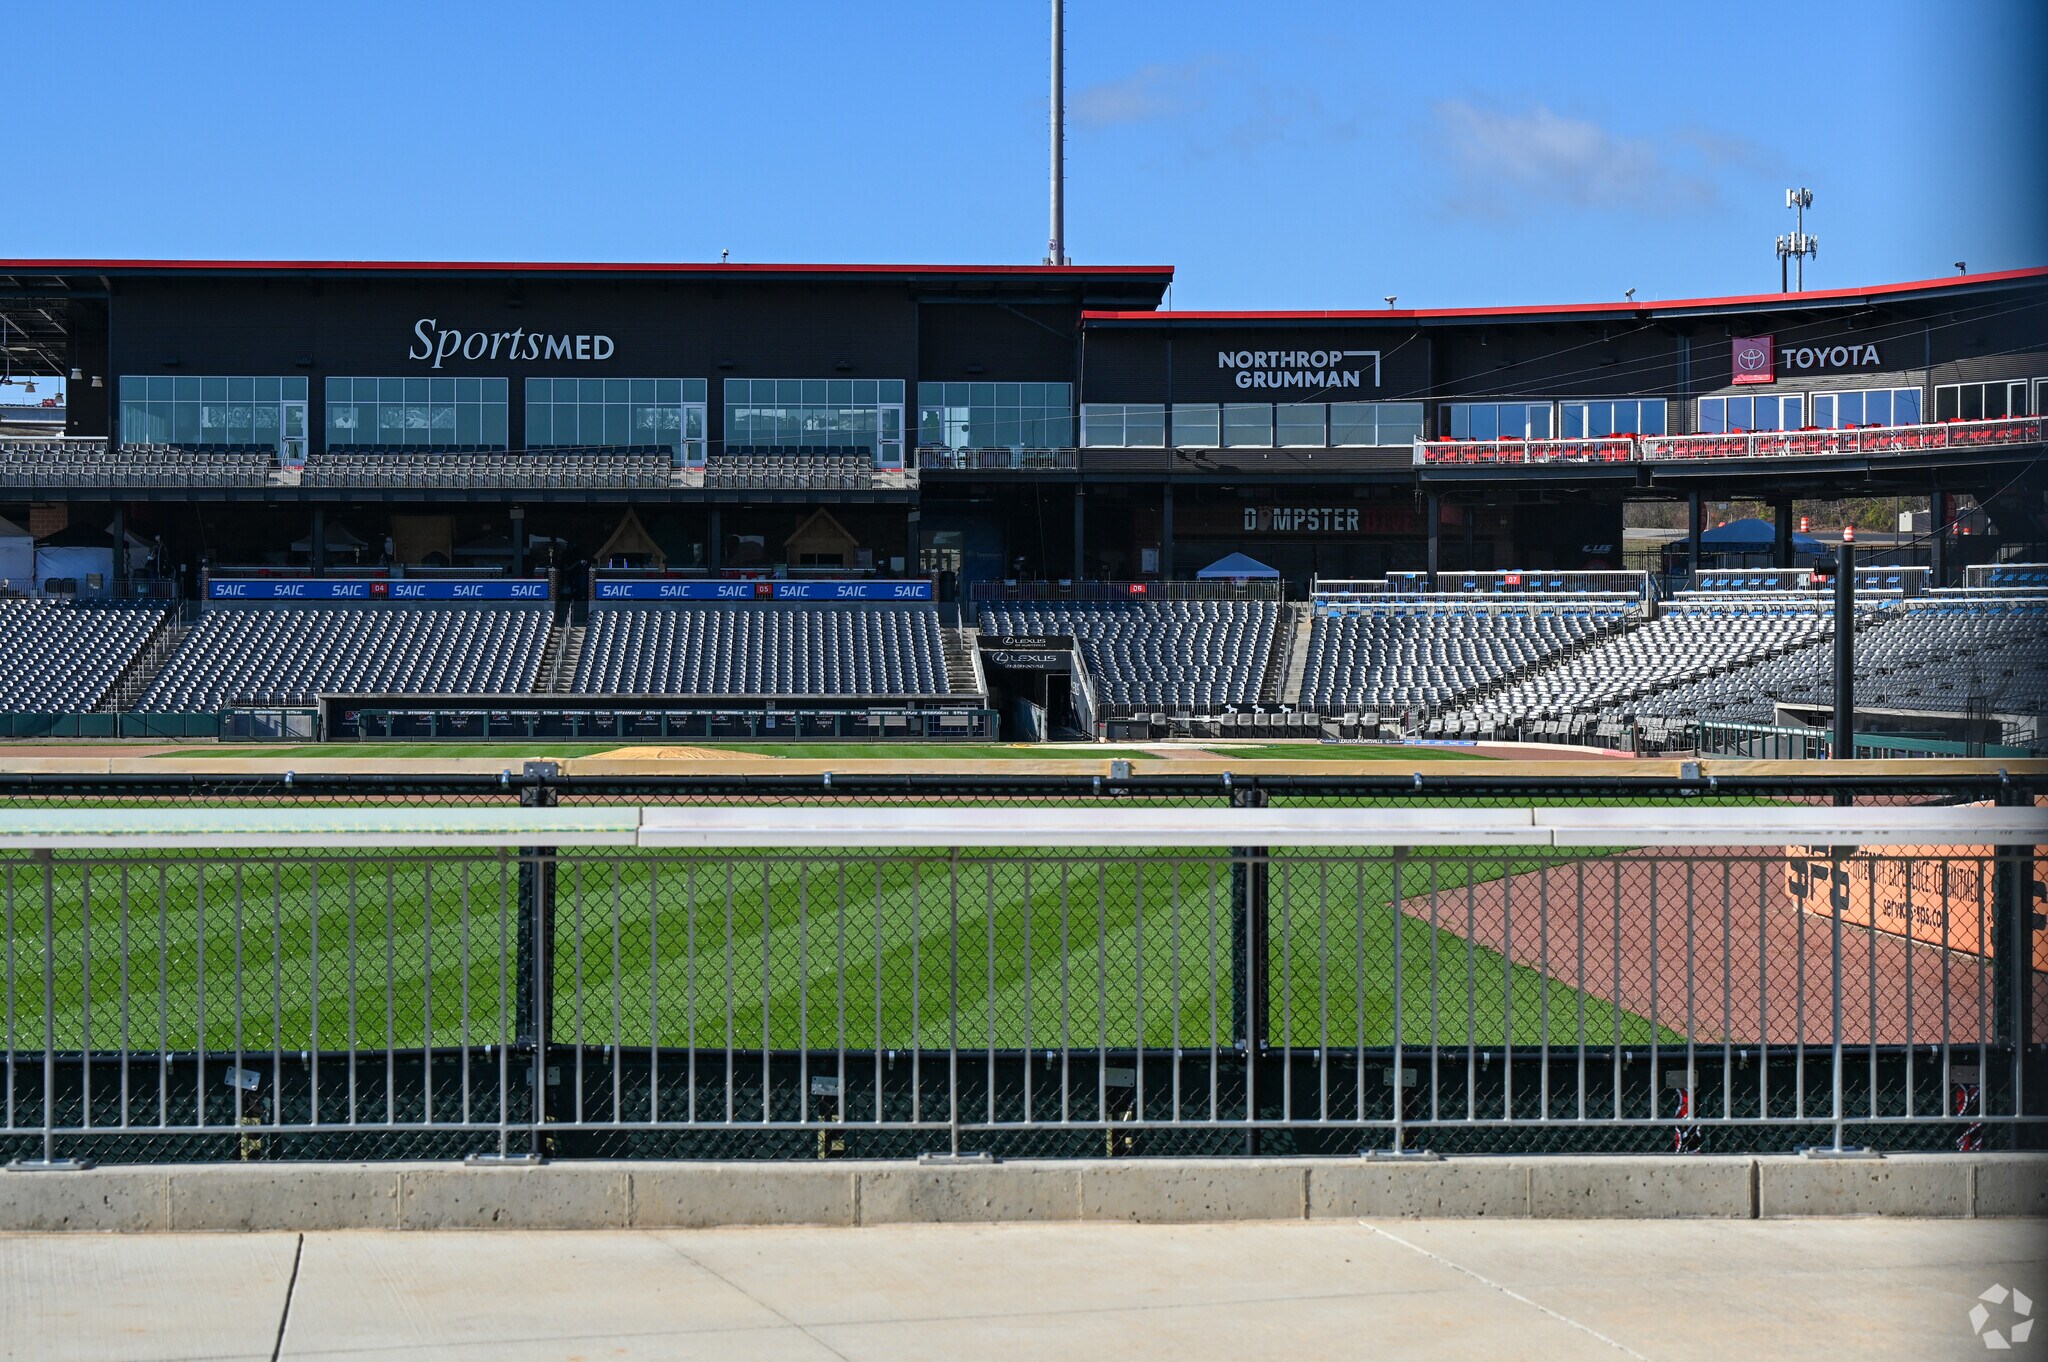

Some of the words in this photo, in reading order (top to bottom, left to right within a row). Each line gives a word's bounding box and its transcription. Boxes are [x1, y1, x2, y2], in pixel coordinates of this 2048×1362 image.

[1218, 350, 1343, 369] NORTHROP
[1781, 345, 1881, 369] TOYOTA
[1235, 370, 1361, 389] GRUMMAN
[215, 584, 246, 596] SAIC
[275, 584, 304, 596] SAIC
[332, 584, 362, 596] SAIC
[395, 584, 425, 596] SAIC
[453, 584, 483, 596] SAIC
[511, 584, 541, 596] SAIC
[602, 585, 632, 597] SAIC
[660, 585, 690, 597] SAIC
[718, 585, 747, 597] SAIC
[780, 585, 810, 597] SAIC
[837, 585, 867, 597] SAIC
[894, 585, 924, 597] SAIC
